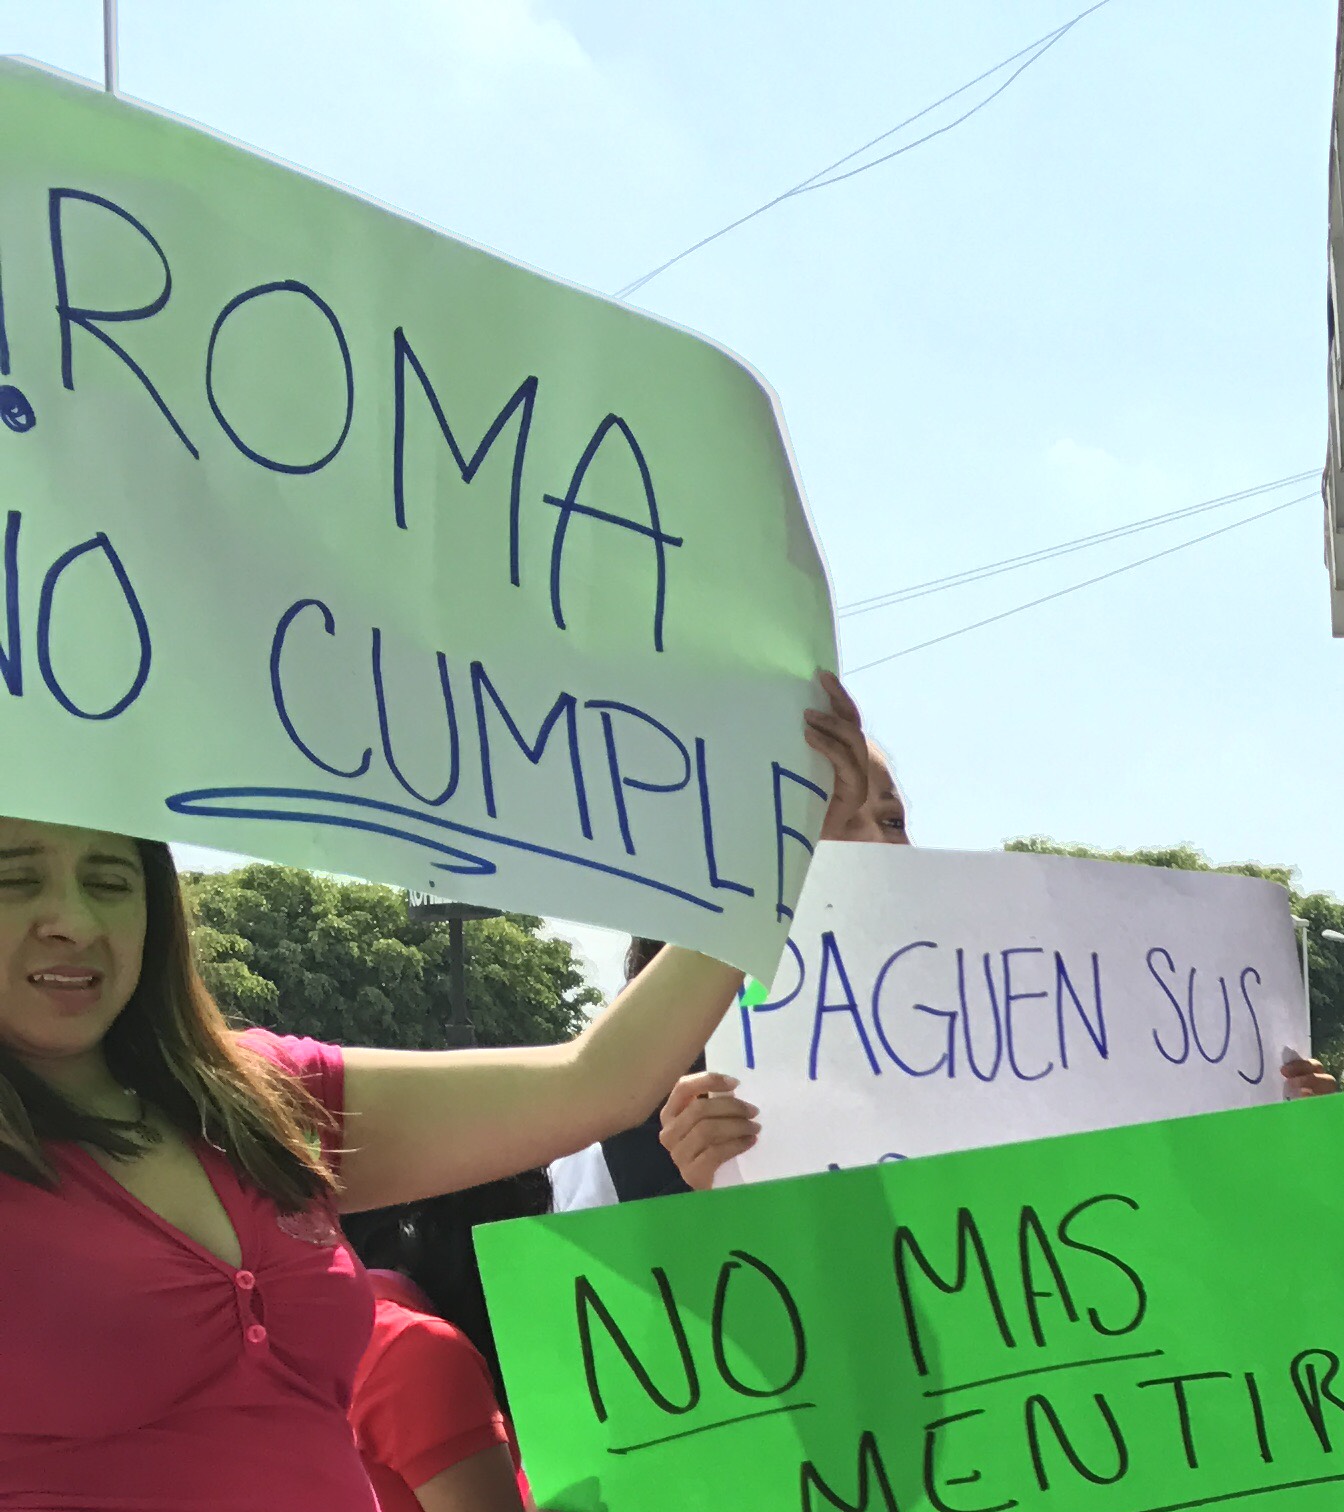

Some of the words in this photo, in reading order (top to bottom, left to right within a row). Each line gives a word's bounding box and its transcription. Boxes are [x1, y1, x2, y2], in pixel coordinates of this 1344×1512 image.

[737, 931, 1108, 1082] PAGUEN
[1146, 946, 1265, 1085] SUS
[573, 1248, 806, 1424] NO
[893, 1194, 1148, 1377] MAS
